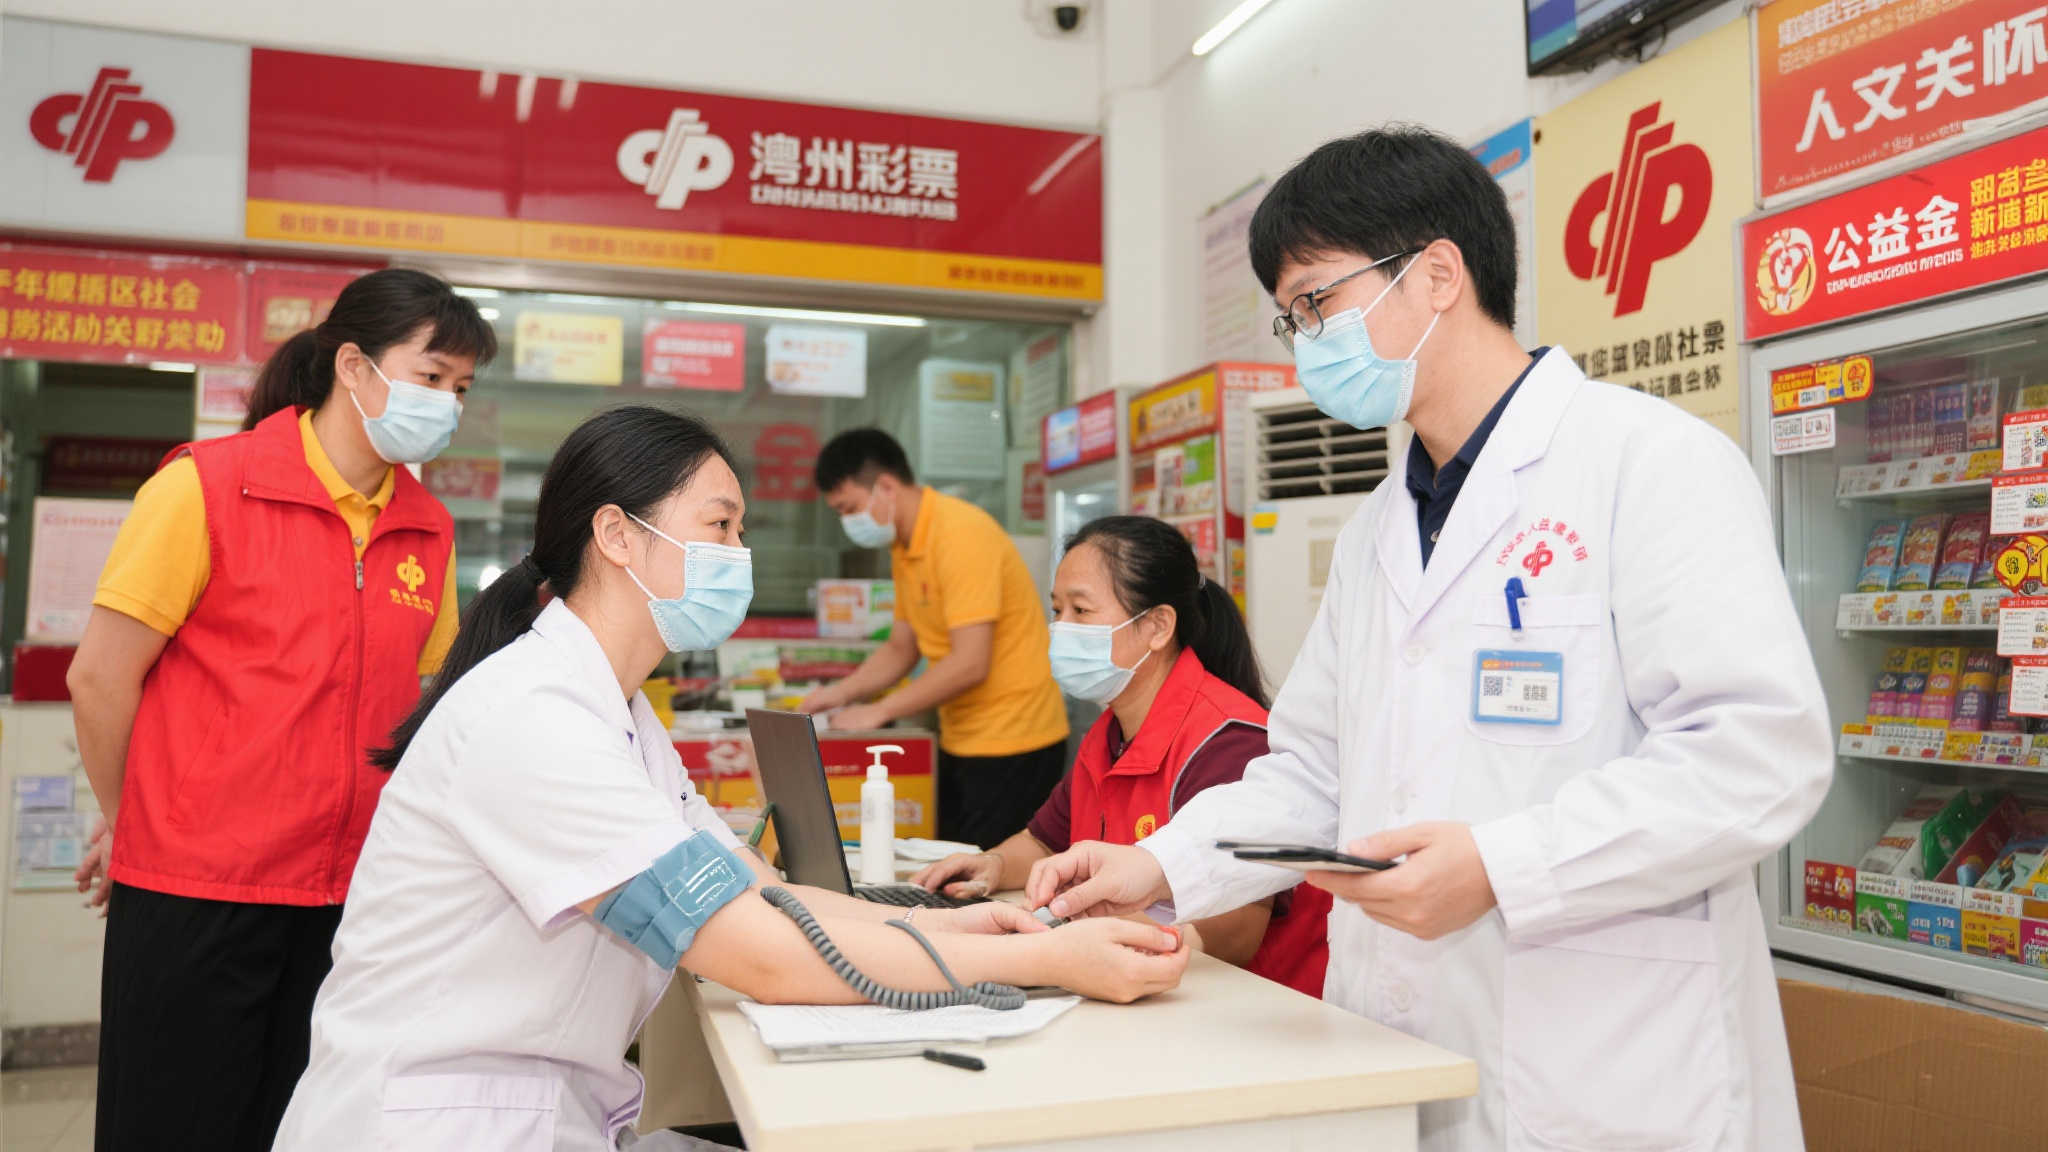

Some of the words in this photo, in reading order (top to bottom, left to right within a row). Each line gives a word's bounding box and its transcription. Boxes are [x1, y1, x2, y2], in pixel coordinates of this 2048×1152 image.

[1796, 6, 2048, 153] 人文关怀
[1823, 194, 1960, 273] 公益金
